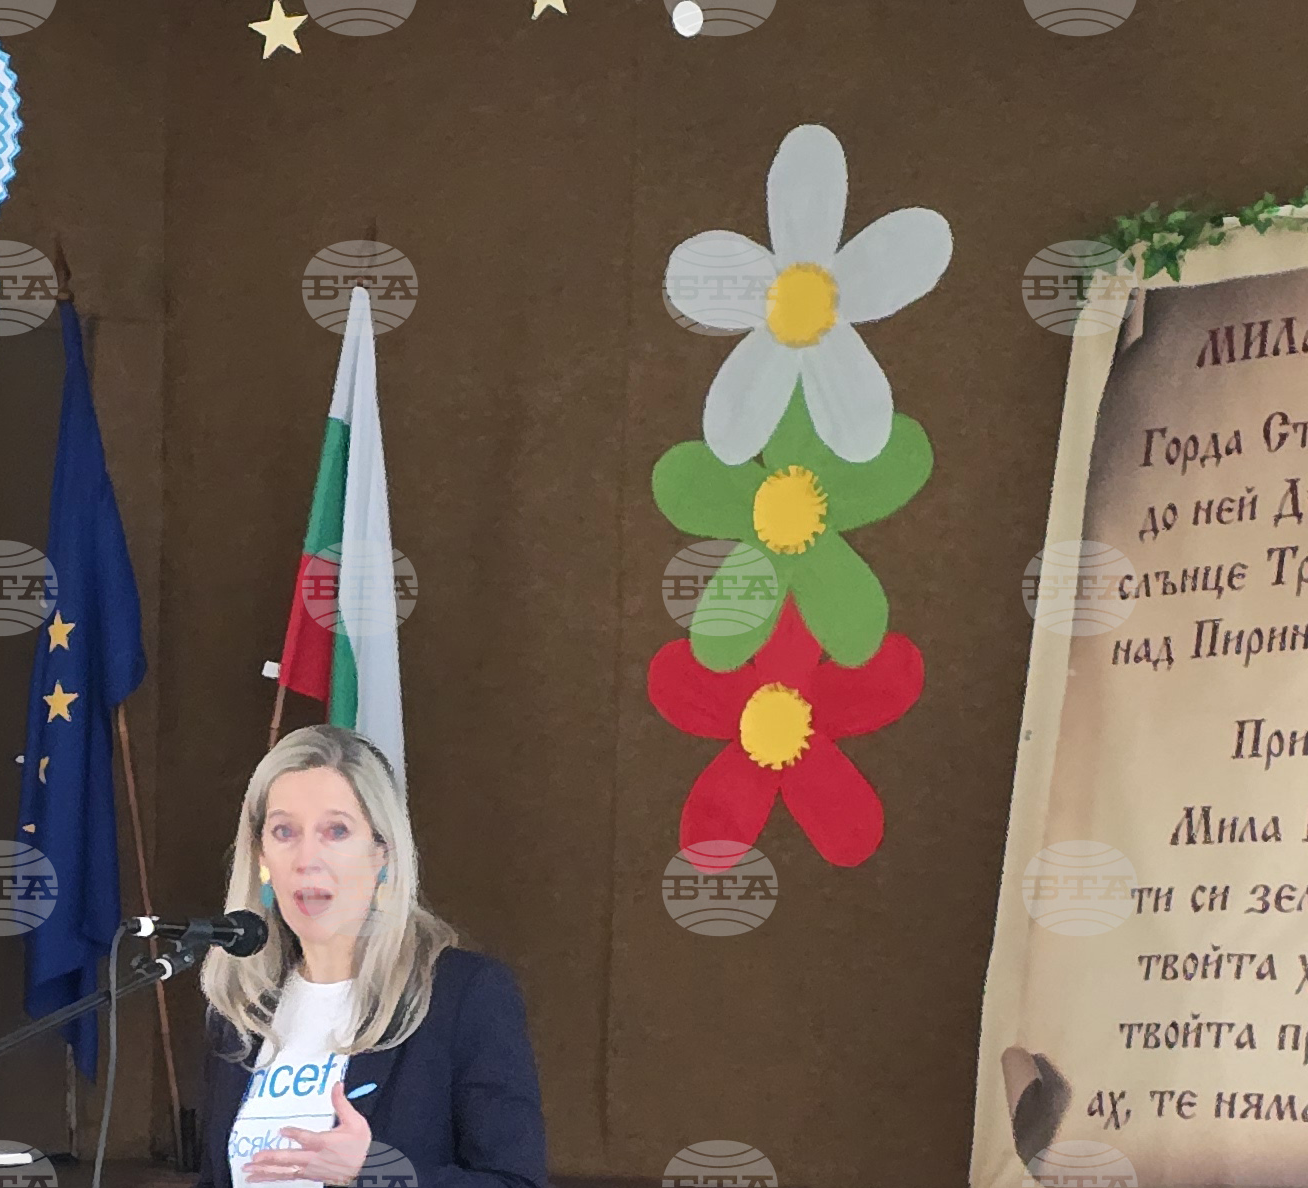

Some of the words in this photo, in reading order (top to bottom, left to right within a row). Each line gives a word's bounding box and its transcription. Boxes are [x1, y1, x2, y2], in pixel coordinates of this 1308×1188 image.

[1139, 425, 1243, 476] Горда
[1139, 502, 1178, 542] до
[1192, 486, 1258, 526] ней
[1273, 478, 1308, 528] Д
[1118, 561, 1248, 602] слънце
[1111, 635, 1174, 671] над
[1190, 618, 1308, 668] Пирин
[1169, 806, 1282, 846] Мила
[1130, 885, 1174, 915] ти
[1191, 884, 1230, 913] си
[1138, 942, 1277, 982] твойта
[1119, 1014, 1257, 1051] твойта
[1087, 1090, 1131, 1130] ах,
[1150, 1090, 1198, 1121] те
